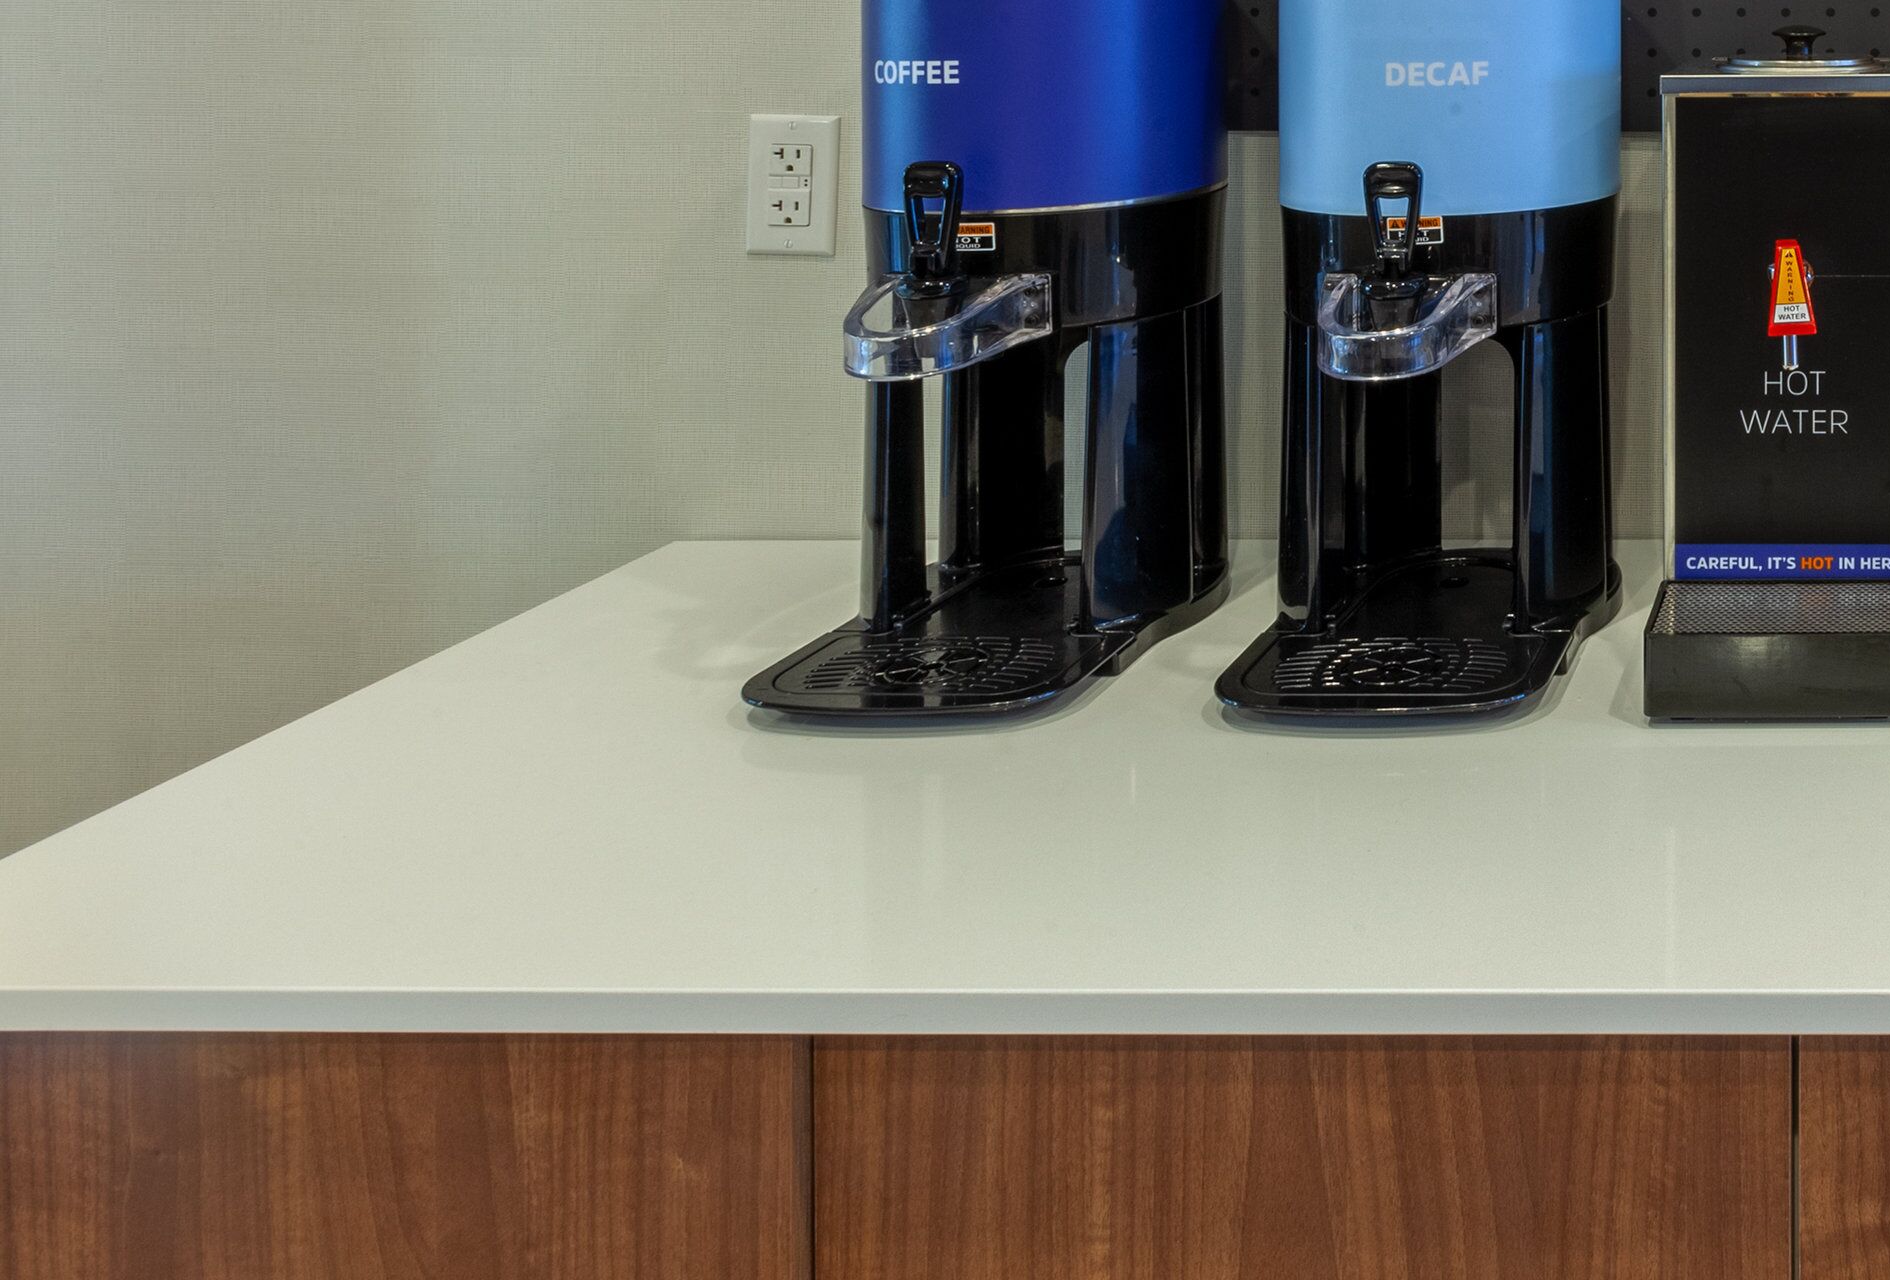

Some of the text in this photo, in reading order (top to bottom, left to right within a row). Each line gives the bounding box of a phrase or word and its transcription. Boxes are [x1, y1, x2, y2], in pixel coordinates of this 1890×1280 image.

[874, 60, 960, 85] COFFEE
[1385, 61, 1489, 87] DECAF
[1764, 370, 1826, 396] HOT
[1739, 409, 1849, 434] WATER
[1686, 556, 1763, 571] CAREFUL,
[1800, 556, 1834, 570] HOT
[1838, 556, 1856, 570] IN
